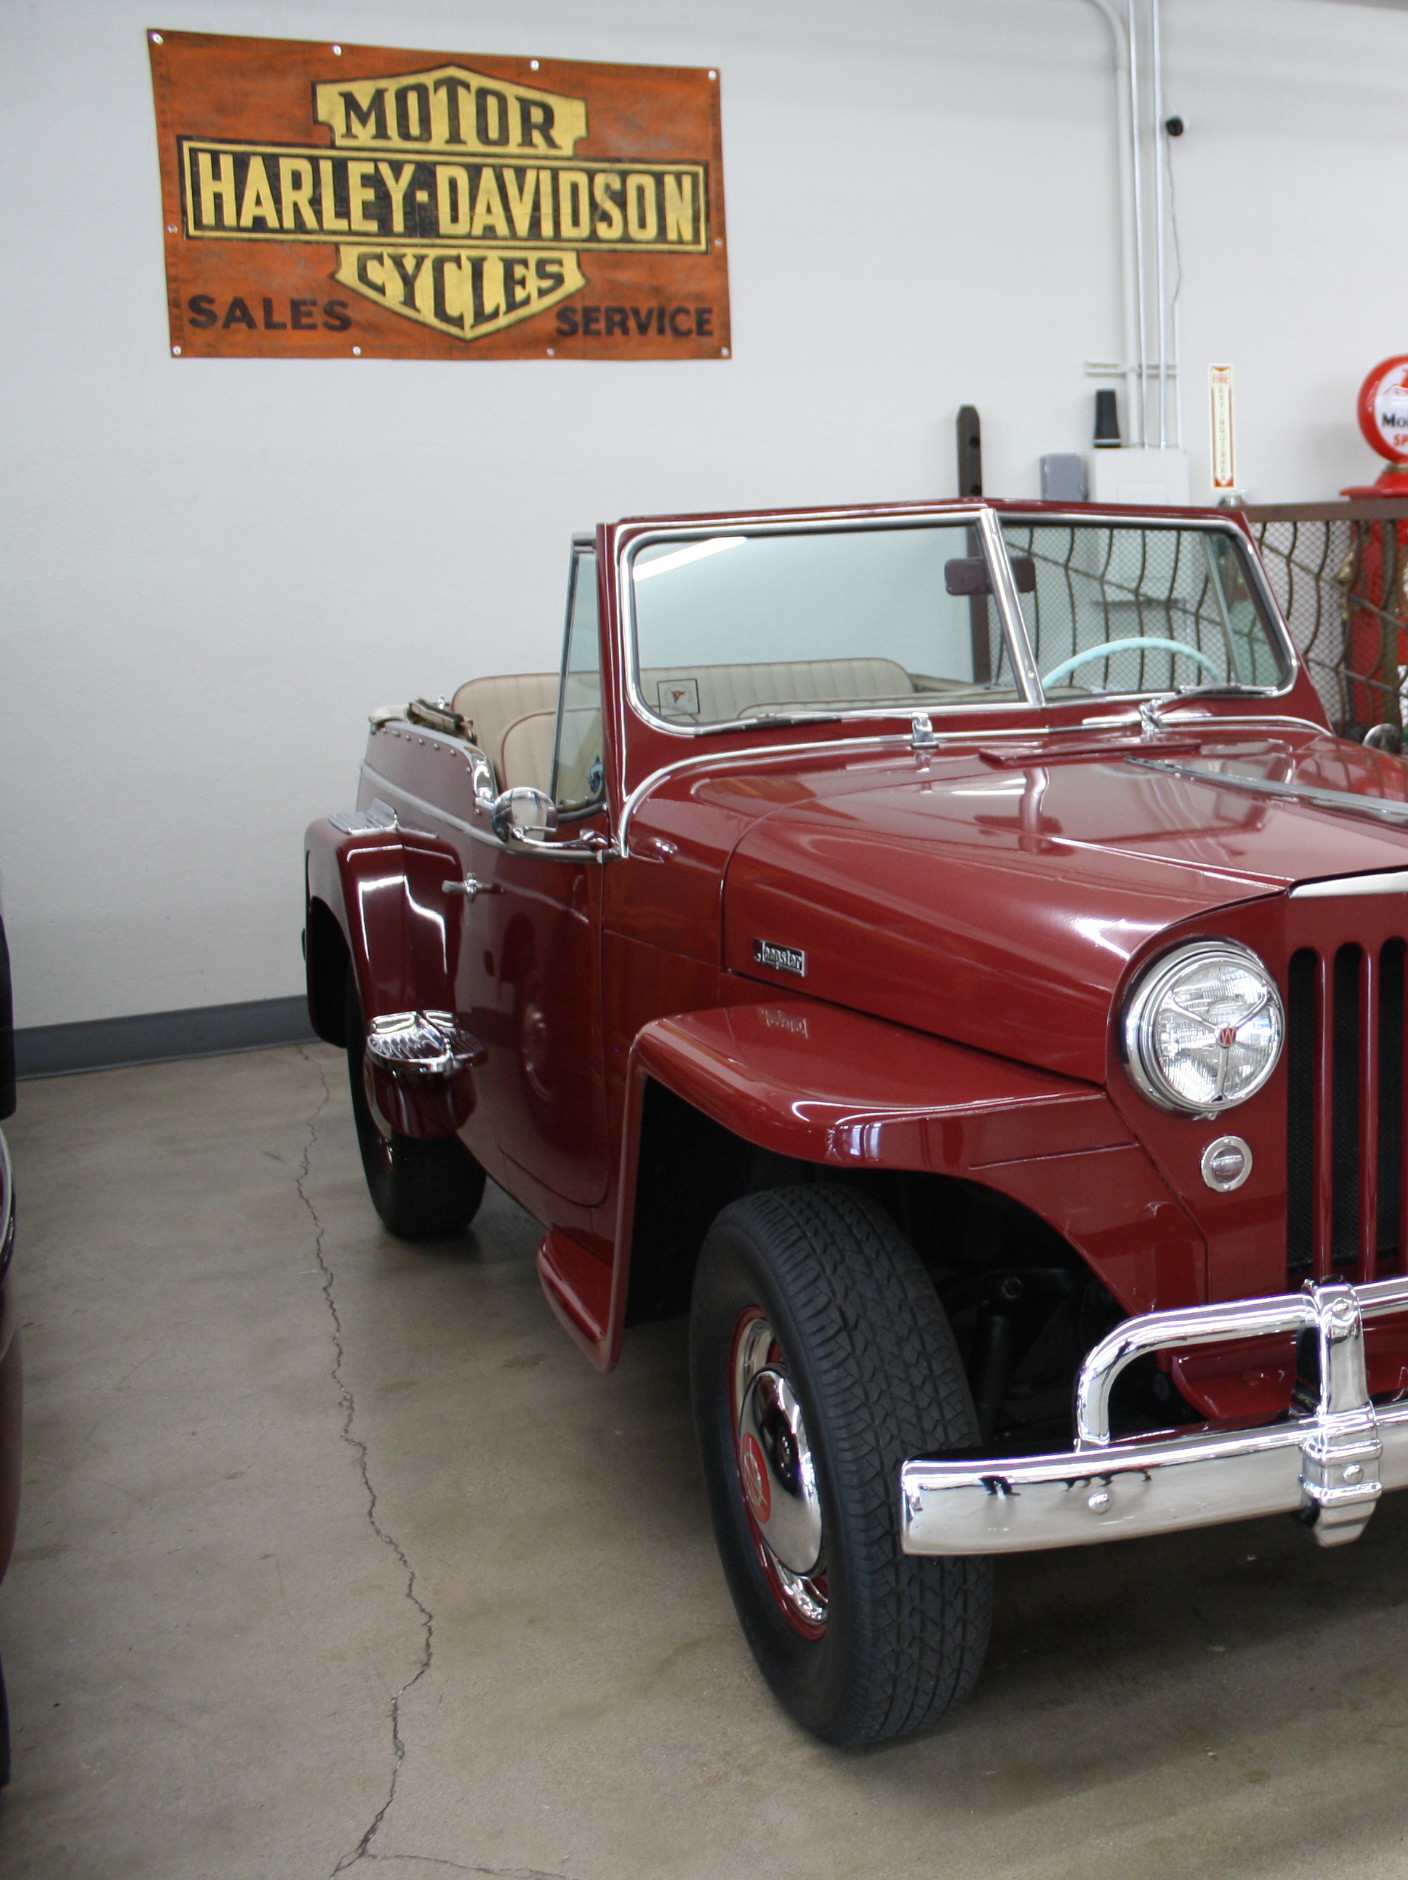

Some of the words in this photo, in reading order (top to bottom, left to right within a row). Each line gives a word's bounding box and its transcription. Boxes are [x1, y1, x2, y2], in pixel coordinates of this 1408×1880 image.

[337, 74, 562, 149] MOTOR
[195, 150, 696, 244] HARLEY-DAVIDSON
[187, 294, 354, 332] SALES
[555, 304, 714, 337] SERVICE
[355, 249, 566, 329] CYCLES
